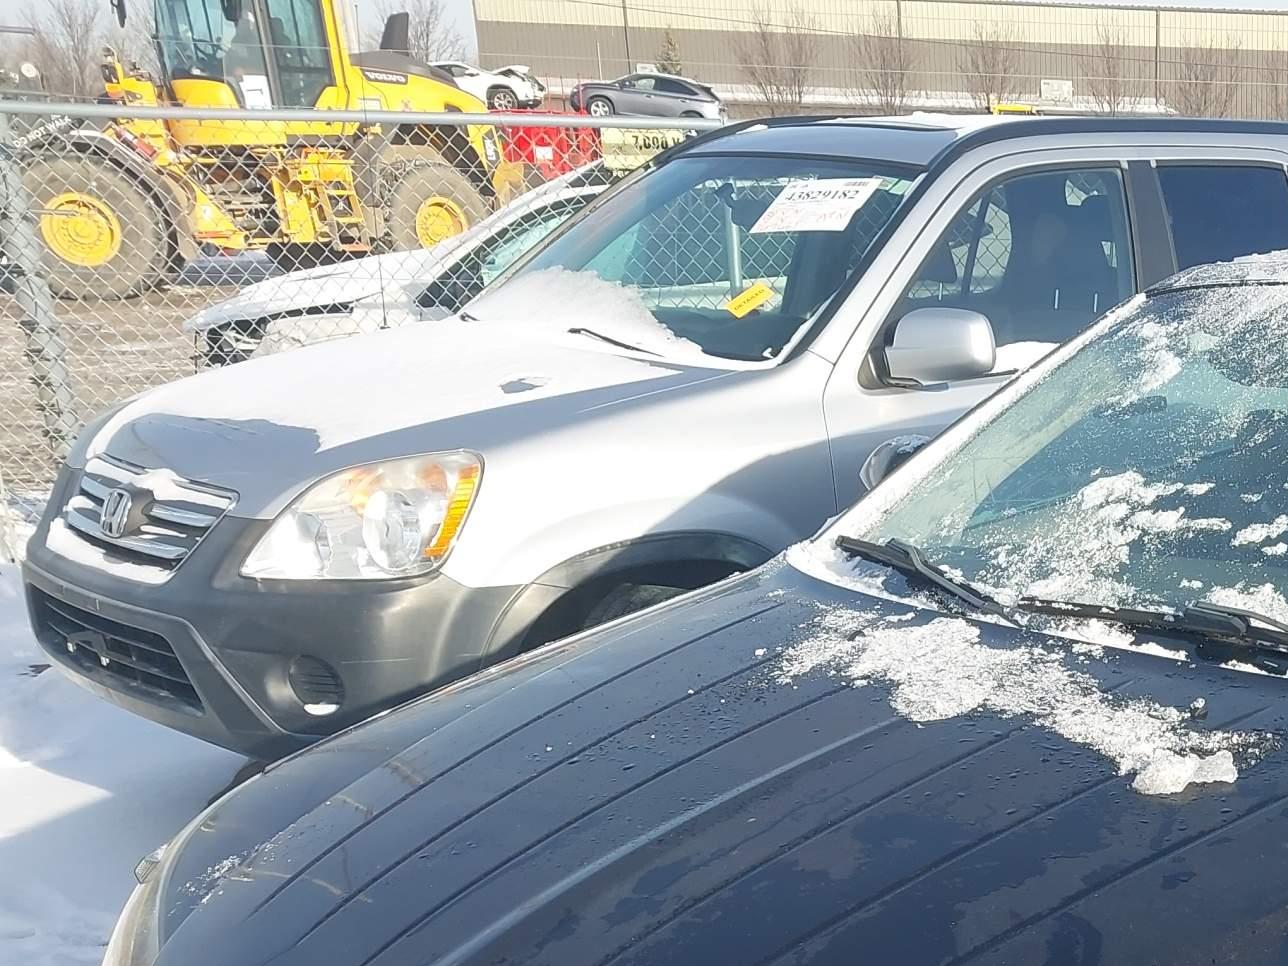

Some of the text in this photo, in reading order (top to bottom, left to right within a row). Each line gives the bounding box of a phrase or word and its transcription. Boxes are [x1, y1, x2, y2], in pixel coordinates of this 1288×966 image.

[364, 71, 406, 83] VOLVO
[13, 137, 28, 148] DO
[27, 127, 47, 142] NOT
